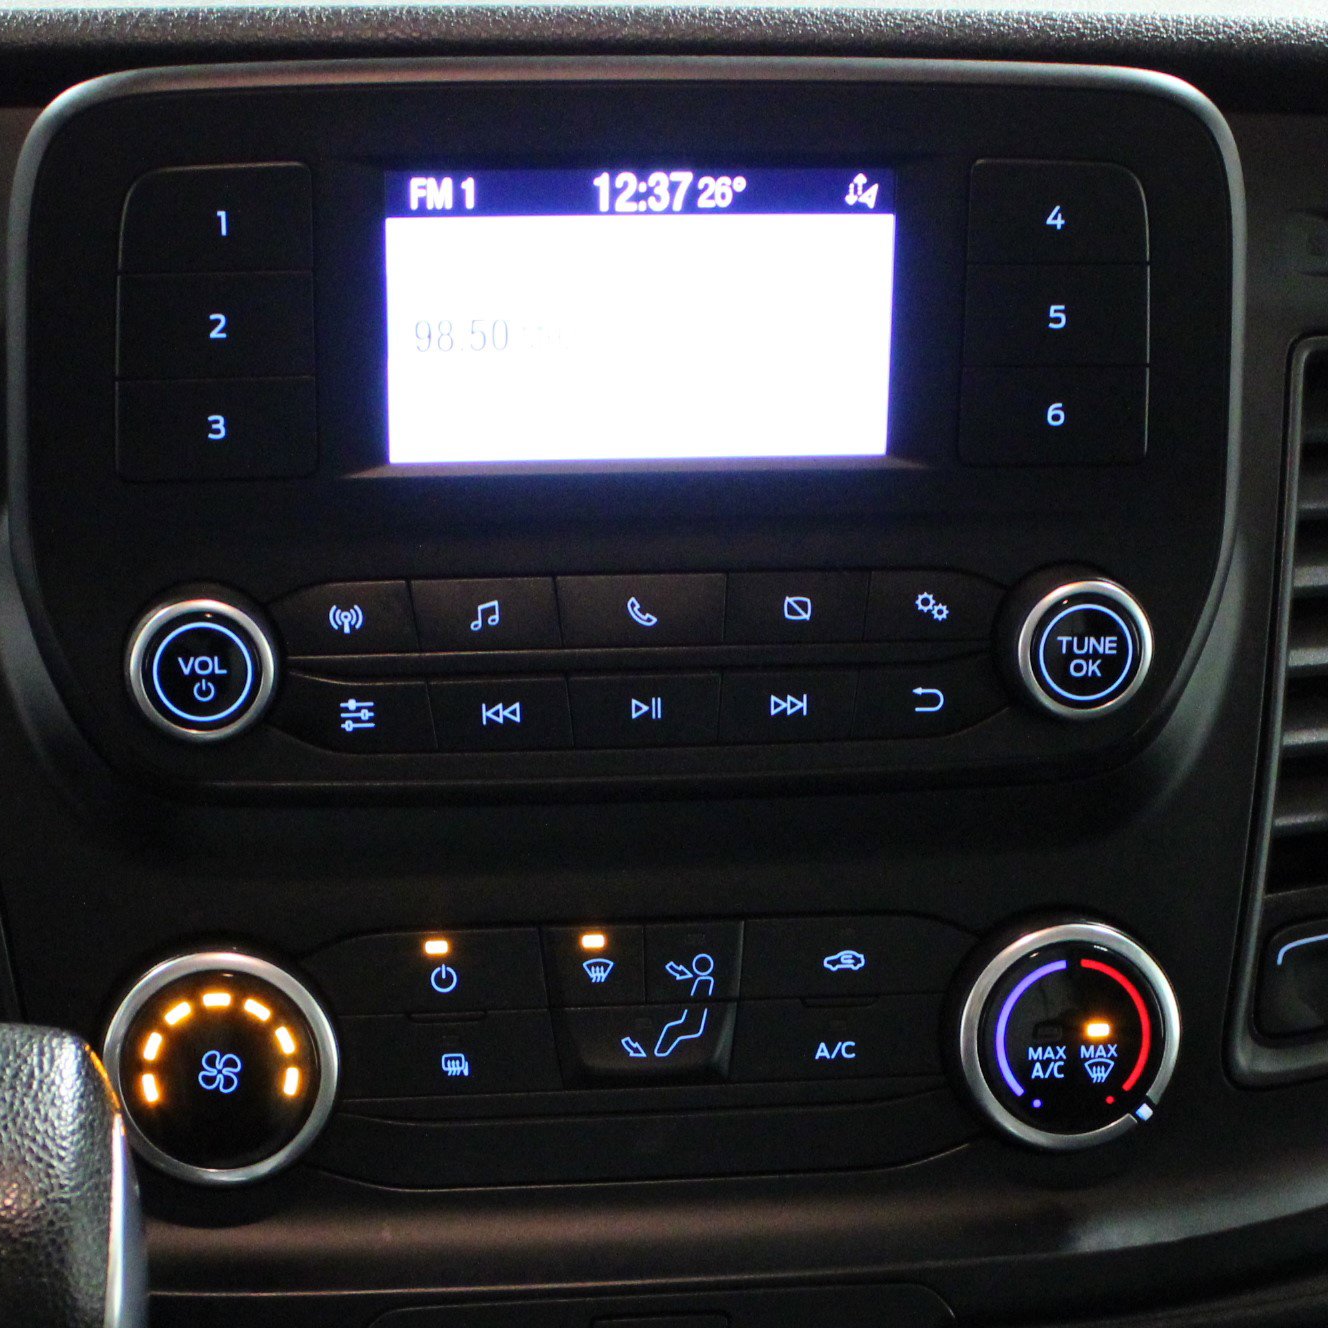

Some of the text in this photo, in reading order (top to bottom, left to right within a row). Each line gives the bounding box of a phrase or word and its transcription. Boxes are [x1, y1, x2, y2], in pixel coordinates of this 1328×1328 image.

[409, 176, 476, 211] FM 1
[593, 171, 694, 213] 12:37
[697, 175, 747, 209] 26°
[216, 210, 228, 237] 1
[1045, 205, 1066, 230] 4
[209, 313, 227, 339] 2
[1048, 304, 1067, 330] 5
[415, 319, 509, 353] 98.50
[1046, 402, 1065, 427] 6
[207, 414, 227, 441] 3
[1056, 636, 1118, 657] TUNE
[177, 656, 228, 677] VOL
[1069, 657, 1102, 678] OK
[814, 1041, 856, 1061] A/C
[1027, 1045, 1067, 1061] MAX
[1079, 1043, 1118, 1059] MAX
[1030, 1061, 1065, 1079] A/C
